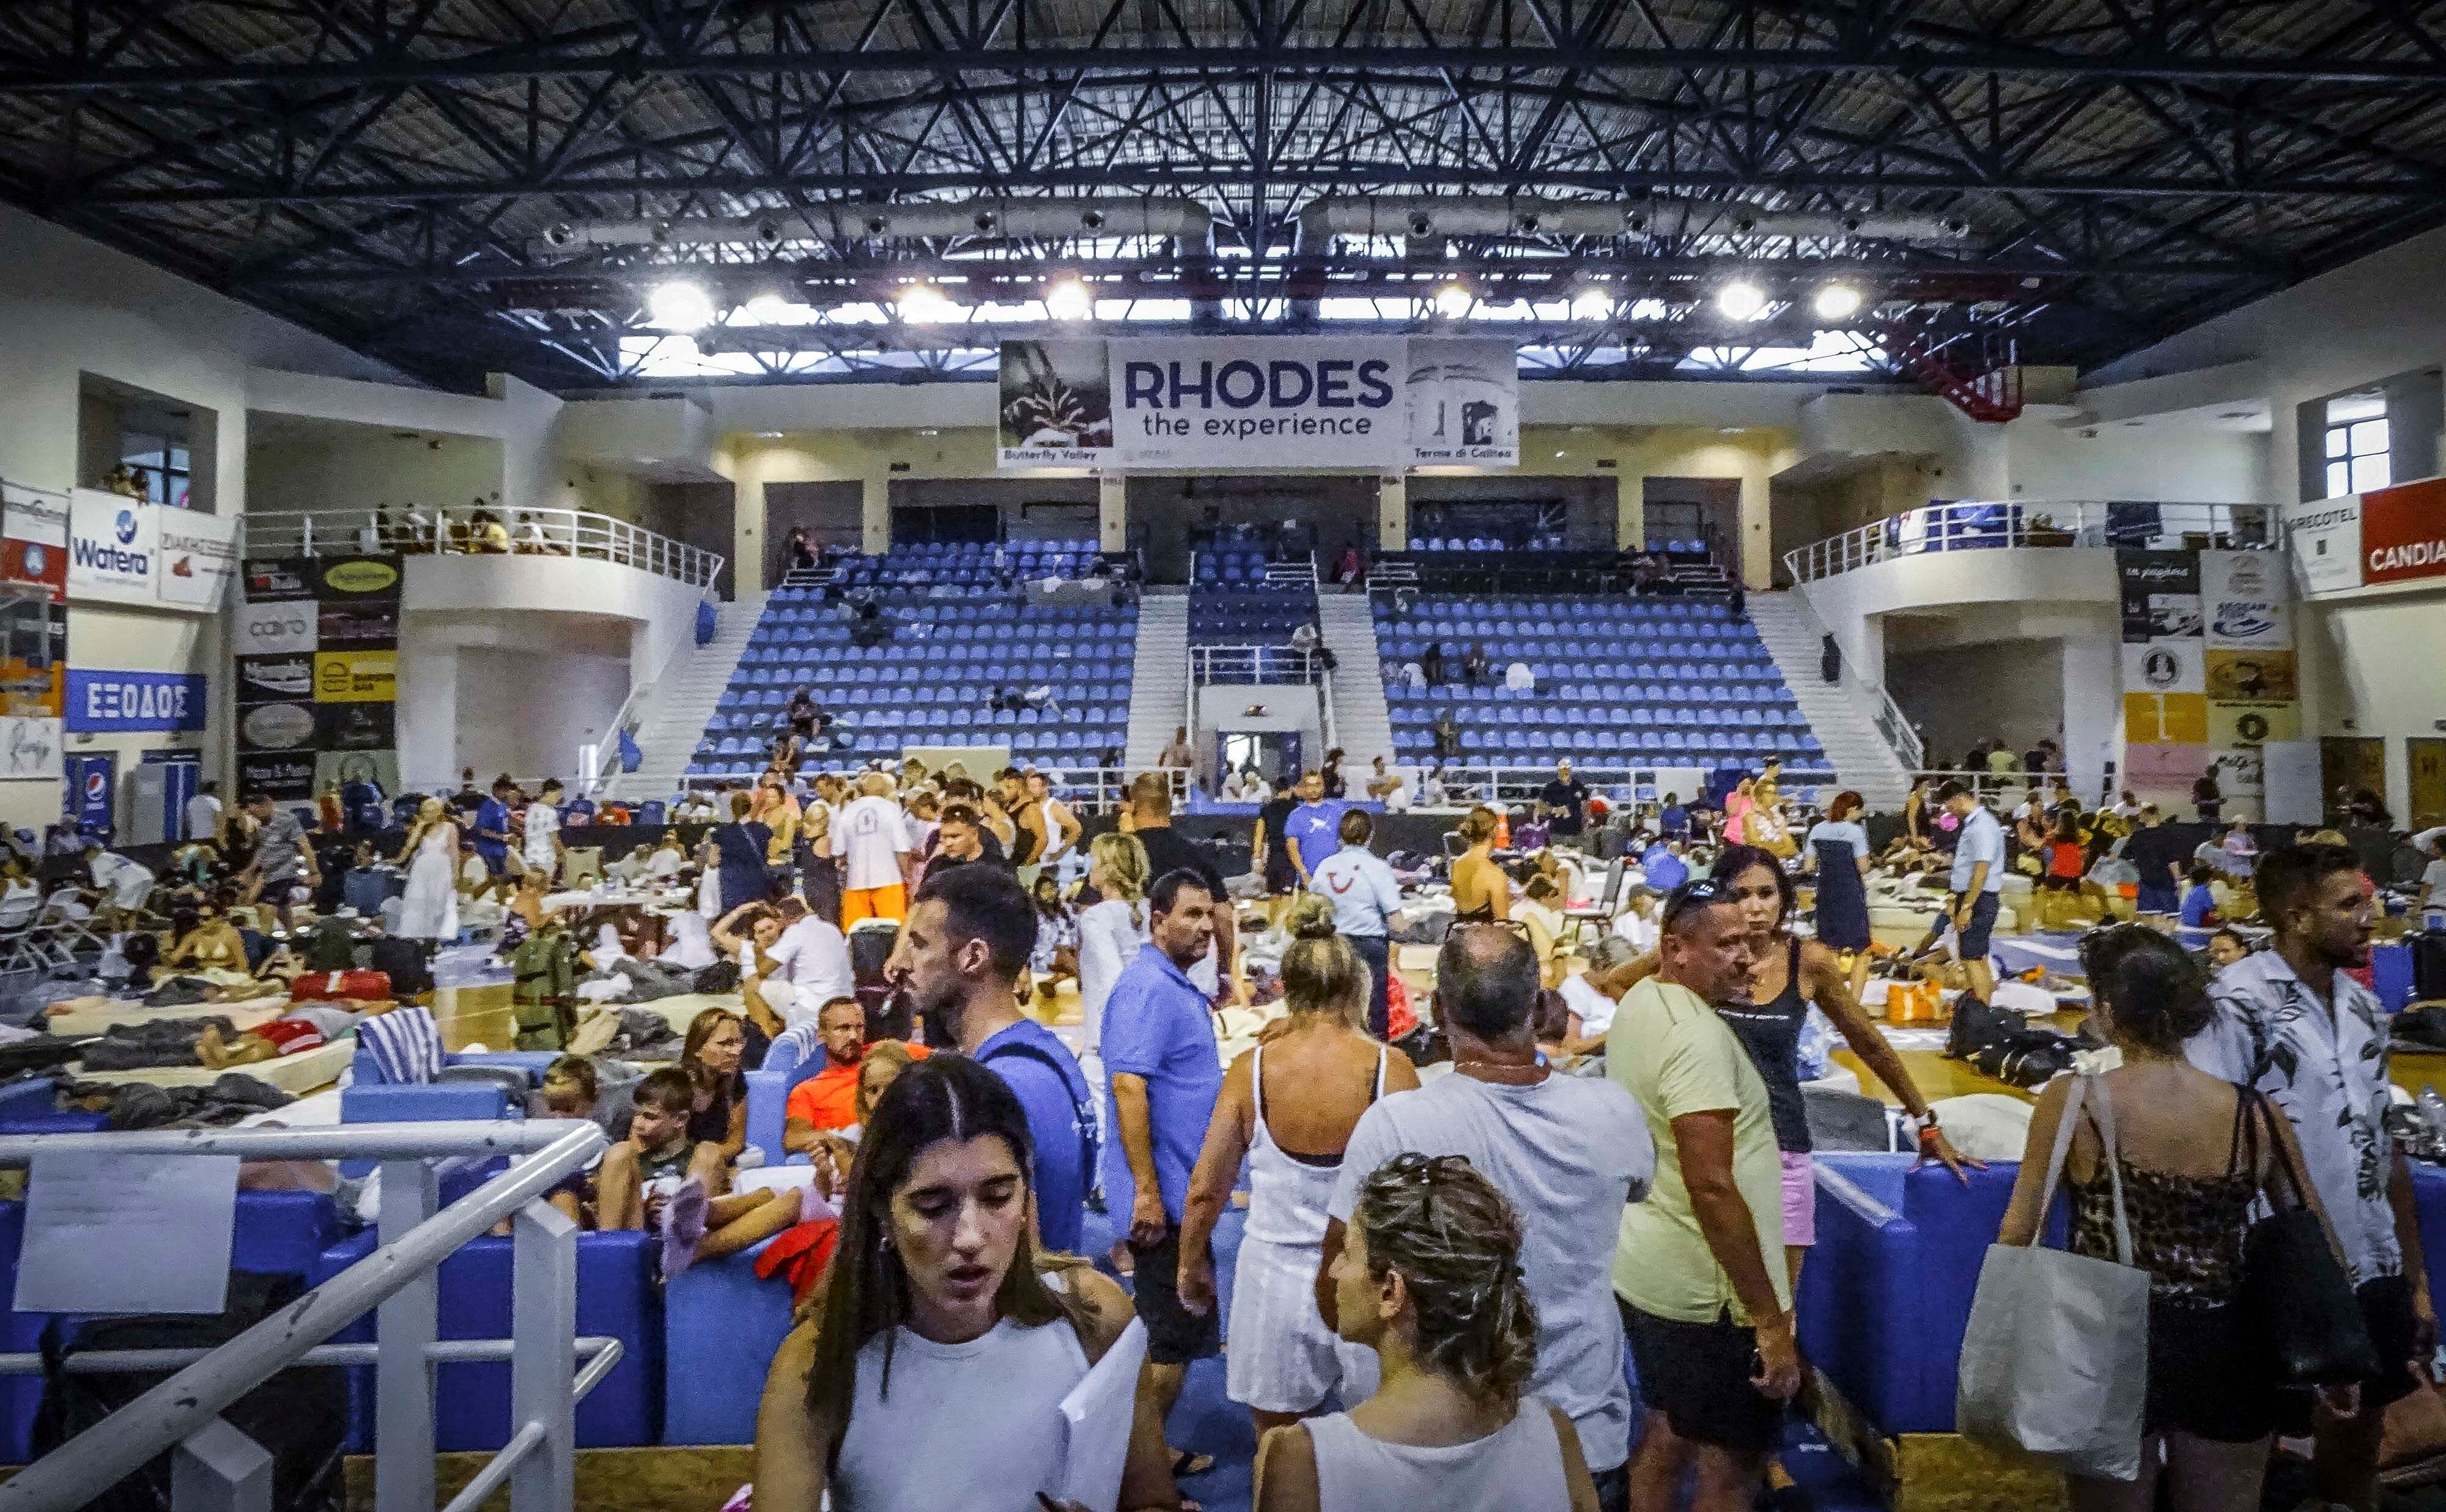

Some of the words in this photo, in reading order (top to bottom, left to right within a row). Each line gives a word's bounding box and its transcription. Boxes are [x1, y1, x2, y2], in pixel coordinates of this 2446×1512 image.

[1125, 360, 1394, 410] RHODES
[1144, 413, 1190, 436] the
[1203, 413, 1372, 441] experience
[1005, 449, 1056, 460] Butterfly
[1061, 449, 1096, 460] Valley
[73, 538, 148, 575] Watera
[2370, 540, 2446, 572] CANDIA
[87, 682, 190, 718] ΕΞΟΔΟΣ
